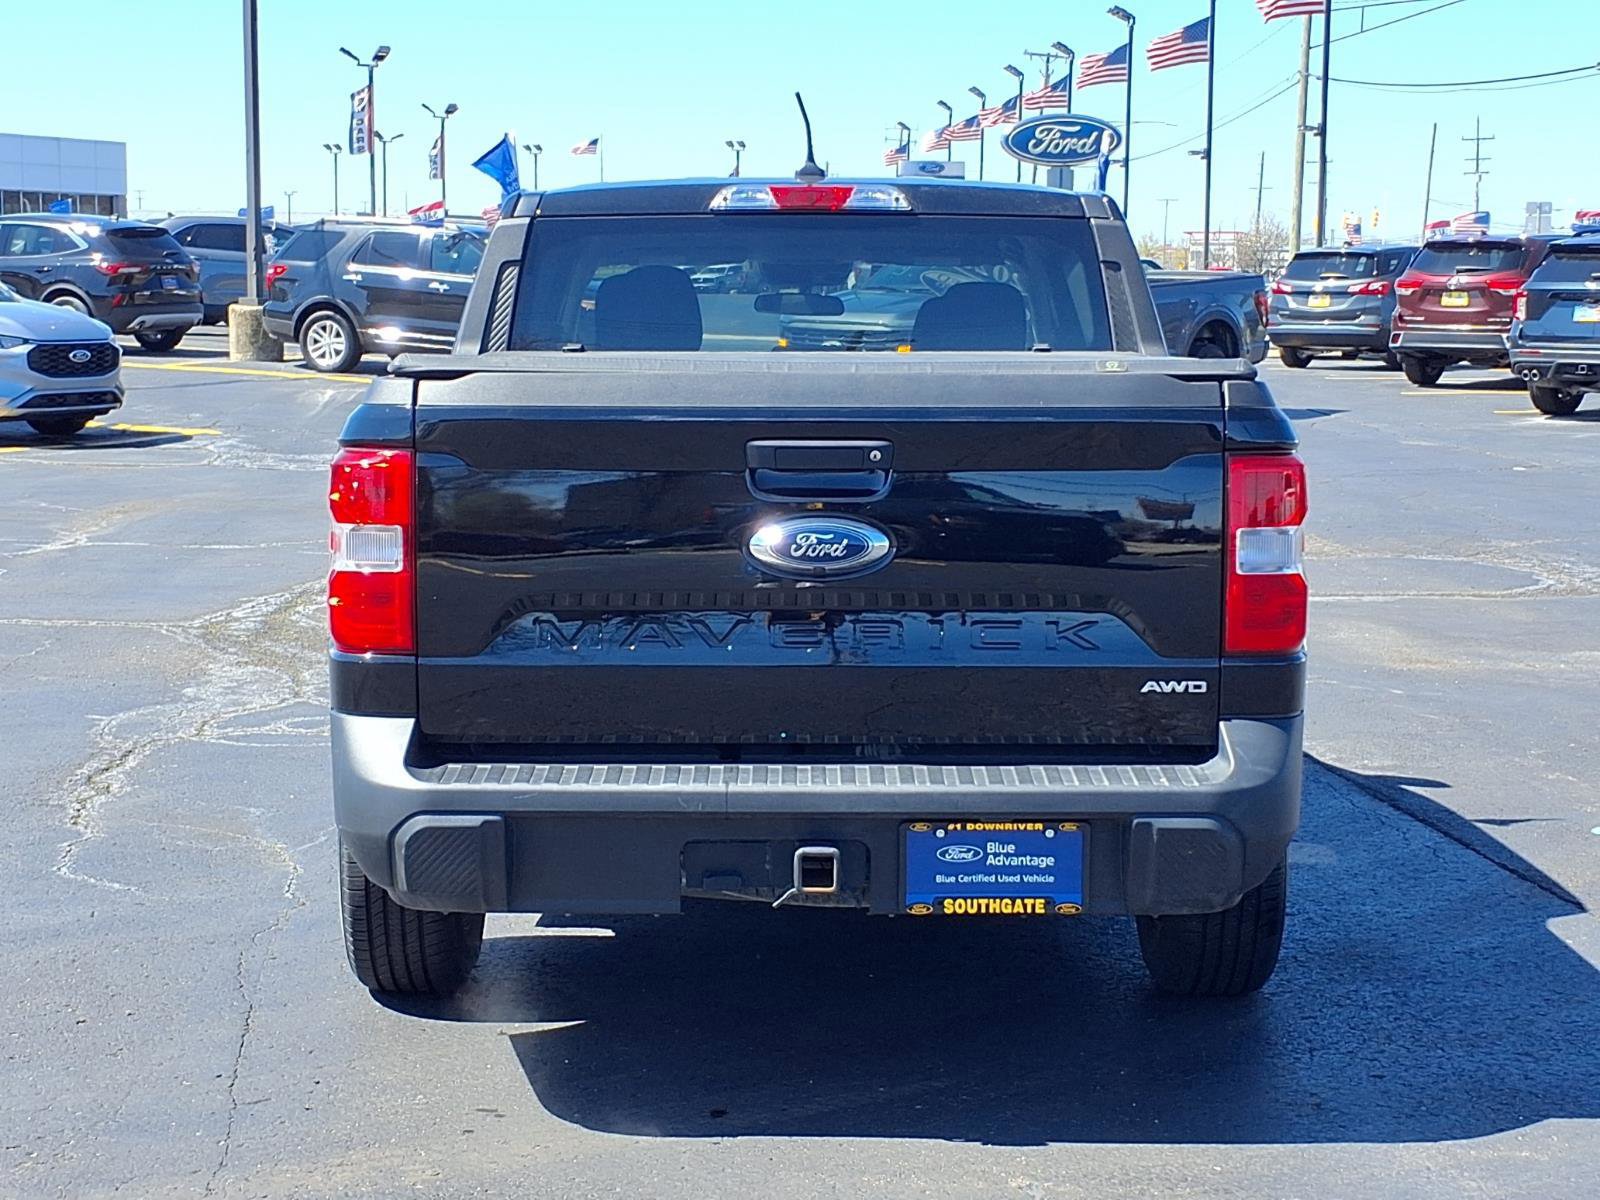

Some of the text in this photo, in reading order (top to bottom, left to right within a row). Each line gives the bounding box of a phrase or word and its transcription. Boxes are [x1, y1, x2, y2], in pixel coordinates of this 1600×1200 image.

[1027, 125, 1098, 154] Ford
[790, 532, 848, 557] Ford
[533, 617, 1101, 650] MAVERICK
[1140, 680, 1207, 693] AWD
[966, 823, 1044, 831] DOWNRIVER
[945, 848, 974, 859] Ford
[986, 842, 1016, 854] Blue
[986, 855, 1055, 868] Advantage
[936, 874, 1055, 883] Blue Certified Used Vehicle
[943, 898, 1046, 914] SOUTHGATE
